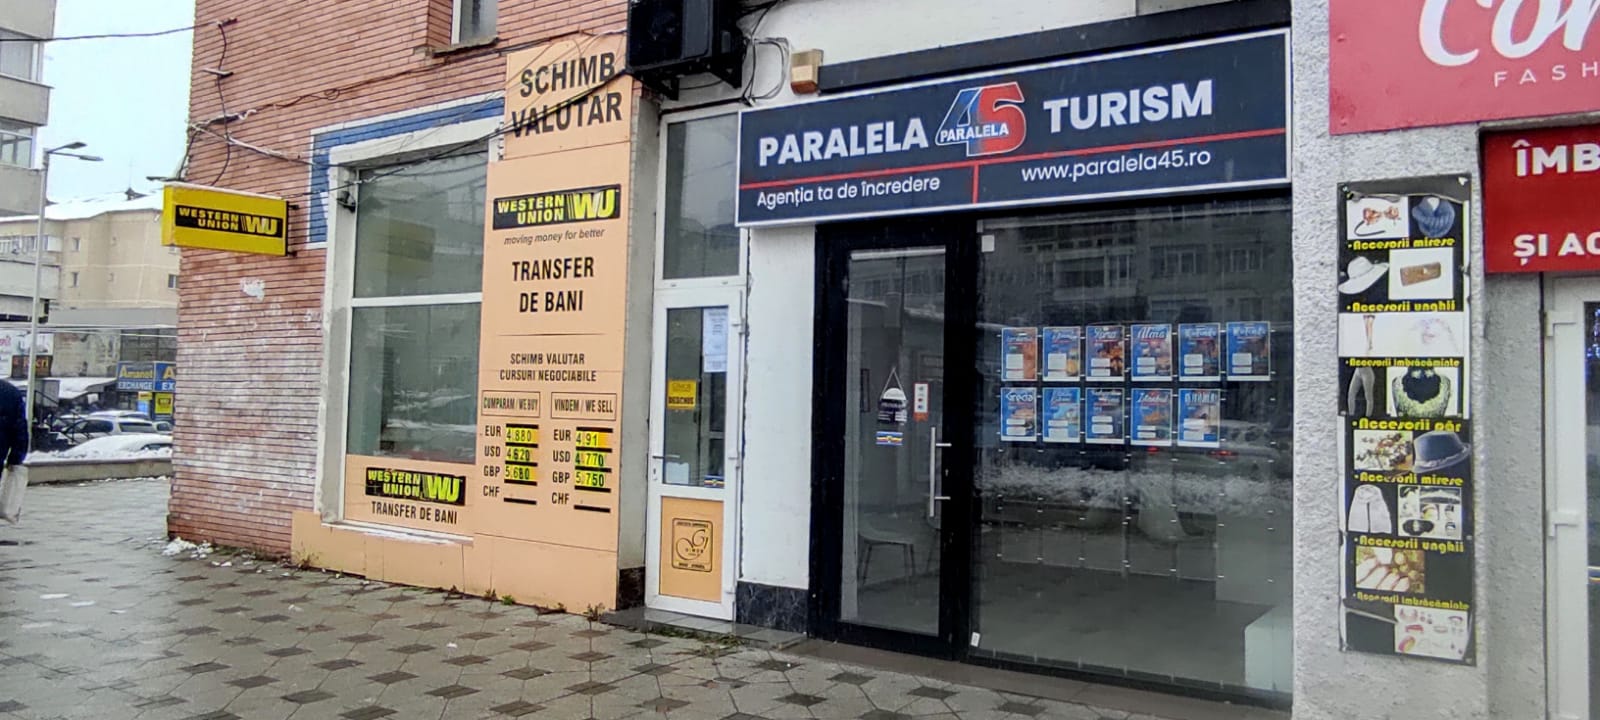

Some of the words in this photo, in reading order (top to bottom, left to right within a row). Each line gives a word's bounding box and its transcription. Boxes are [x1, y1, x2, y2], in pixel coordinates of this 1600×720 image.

[519, 52, 617, 98] SCHIMB
[1494, 62, 1598, 87] FASH
[511, 91, 622, 137] VALUTAR
[1043, 79, 1213, 133] TURISM
[940, 123, 1009, 142] PARALELA
[759, 118, 928, 166] PARALELA
[1021, 150, 1211, 182] www.paralela45.ro
[1512, 139, 1600, 177] ÎMB
[757, 188, 813, 210] Agenția
[817, 186, 833, 200] ta
[839, 183, 857, 199] de
[861, 175, 940, 196] încredere
[497, 194, 564, 214] WESTERN
[573, 189, 616, 219] WU
[179, 207, 239, 223] WESTERN
[517, 208, 564, 224] UNION
[198, 218, 239, 231] UNION
[245, 215, 278, 235] WU
[504, 232, 532, 245] moving
[534, 231, 563, 243] money
[564, 229, 577, 241] for
[579, 228, 605, 239] better
[1353, 238, 1410, 250] Accesorii
[1413, 237, 1455, 247] mirese
[1513, 233, 1547, 265] ȘI
[512, 256, 594, 281] TRANSFER
[519, 292, 538, 312] DE
[545, 290, 583, 312] BANI
[1352, 300, 1410, 312] Accesorii
[1414, 300, 1455, 312] unghii
[510, 353, 543, 364] SCHIMB
[546, 353, 585, 364] VALUTAR
[1349, 358, 1391, 367] Accesorii
[500, 369, 536, 381] CURSURI
[538, 370, 596, 382] NEGOCIABILE
[484, 397, 515, 409] CUMPARAM
[554, 400, 580, 412] VINDEM
[585, 400, 596, 412] WE
[598, 400, 613, 413] SELL
[485, 425, 501, 437] EUR
[1359, 418, 1430, 430] Accesorii
[554, 429, 571, 441] EUR
[484, 446, 501, 457] USD
[553, 450, 571, 462] USD
[368, 469, 421, 484] WESTERN
[483, 465, 500, 477] GBP
[552, 471, 570, 484] GBP
[427, 475, 460, 502] WU
[1421, 475, 1463, 486] mirese
[383, 483, 420, 497] UNION
[483, 485, 500, 498] CHF
[552, 492, 570, 505] CHF
[372, 501, 416, 519] TRANSFER
[420, 507, 431, 521] DE
[434, 508, 458, 525] BANI
[1360, 535, 1418, 549] Accesorii
[1422, 541, 1464, 554] unghii
